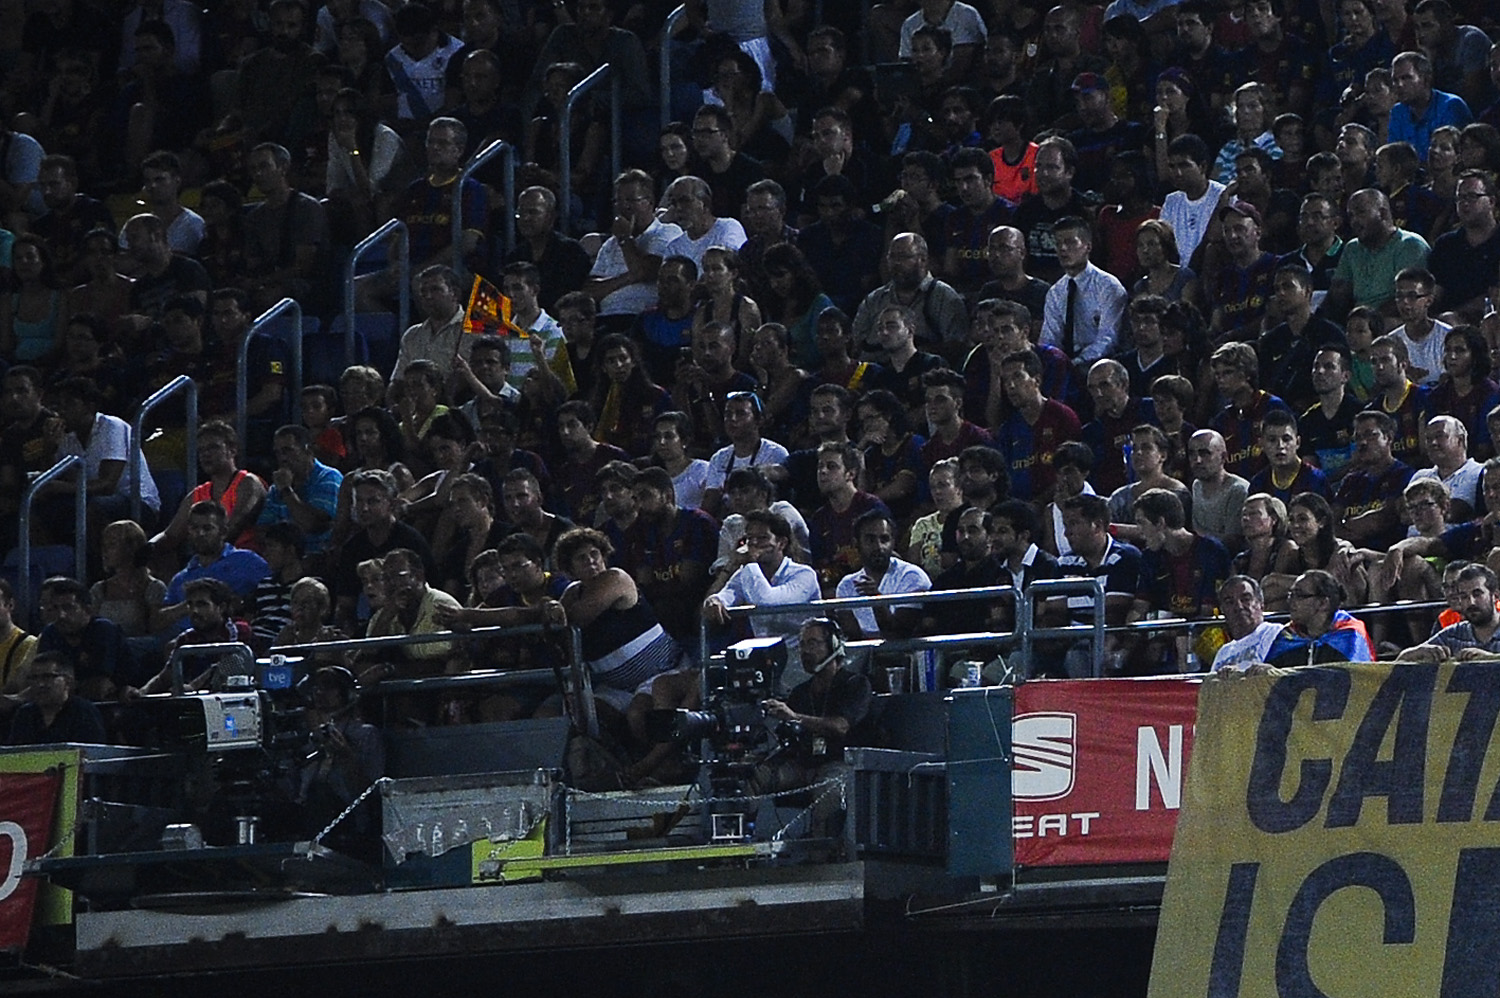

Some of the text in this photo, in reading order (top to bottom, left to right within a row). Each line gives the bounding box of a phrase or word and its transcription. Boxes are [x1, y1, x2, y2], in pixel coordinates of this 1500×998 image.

[755, 671, 764, 683] 3
[1135, 724, 1196, 811] N
[1012, 811, 1100, 838] EAT
